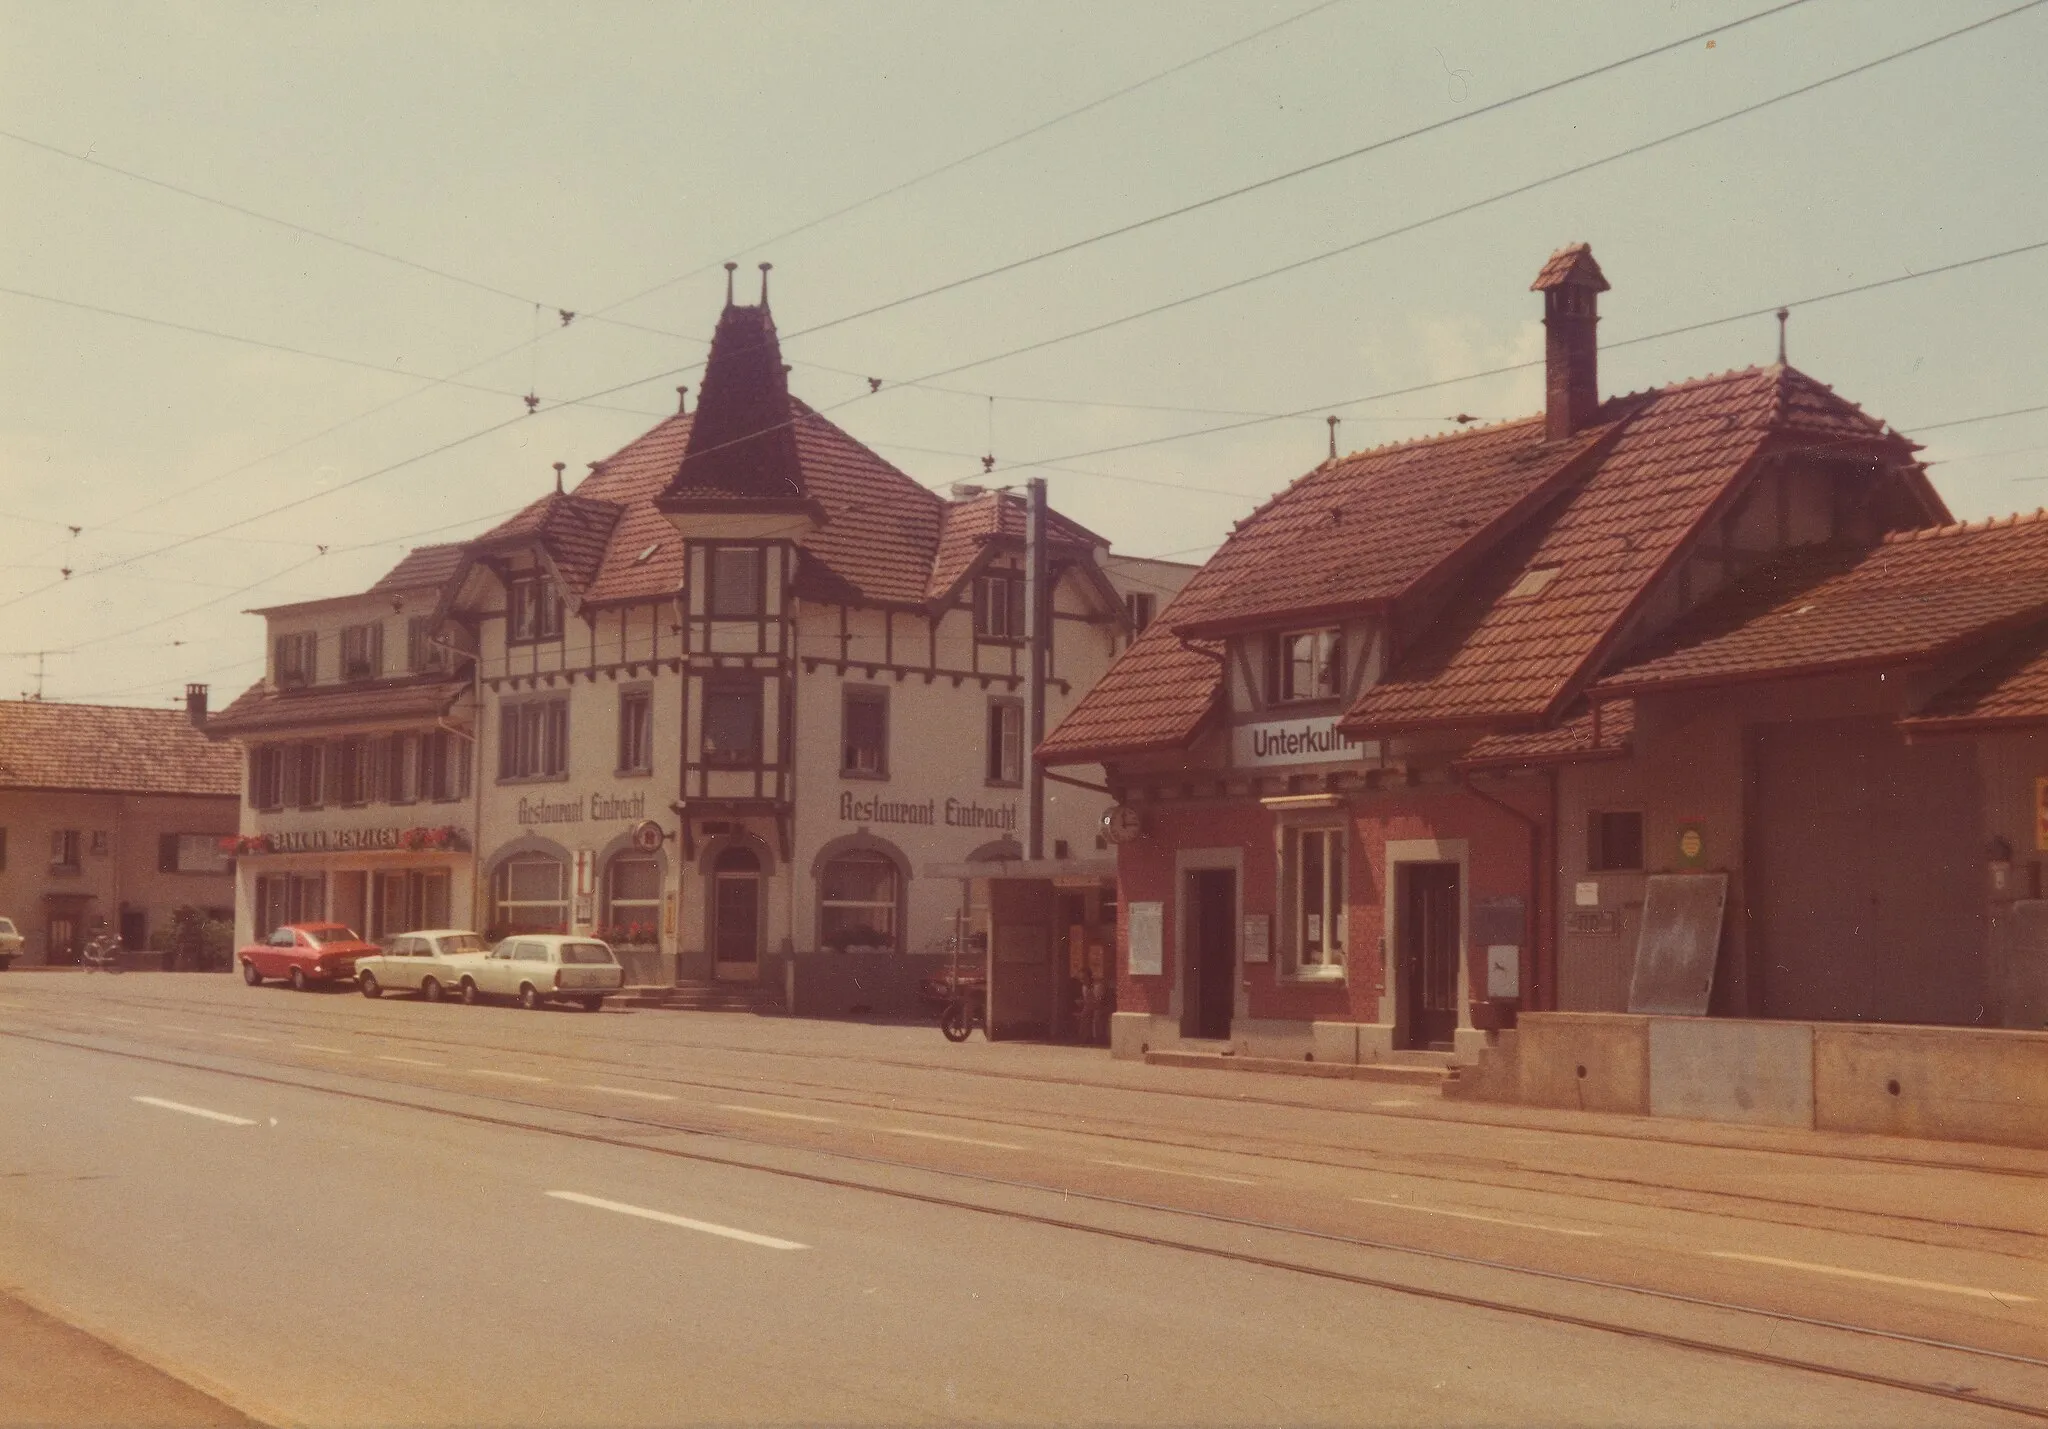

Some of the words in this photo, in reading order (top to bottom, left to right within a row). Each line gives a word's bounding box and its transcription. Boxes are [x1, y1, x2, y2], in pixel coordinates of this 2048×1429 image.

[518, 793, 584, 824] Restaurant
[591, 791, 645, 820] Eintracht
[839, 791, 935, 825] Restaurant
[945, 797, 1017, 829] Eintracht
[273, 831, 308, 851] BANK
[313, 830, 327, 848] IN
[332, 827, 400, 847] MENZIKEN
